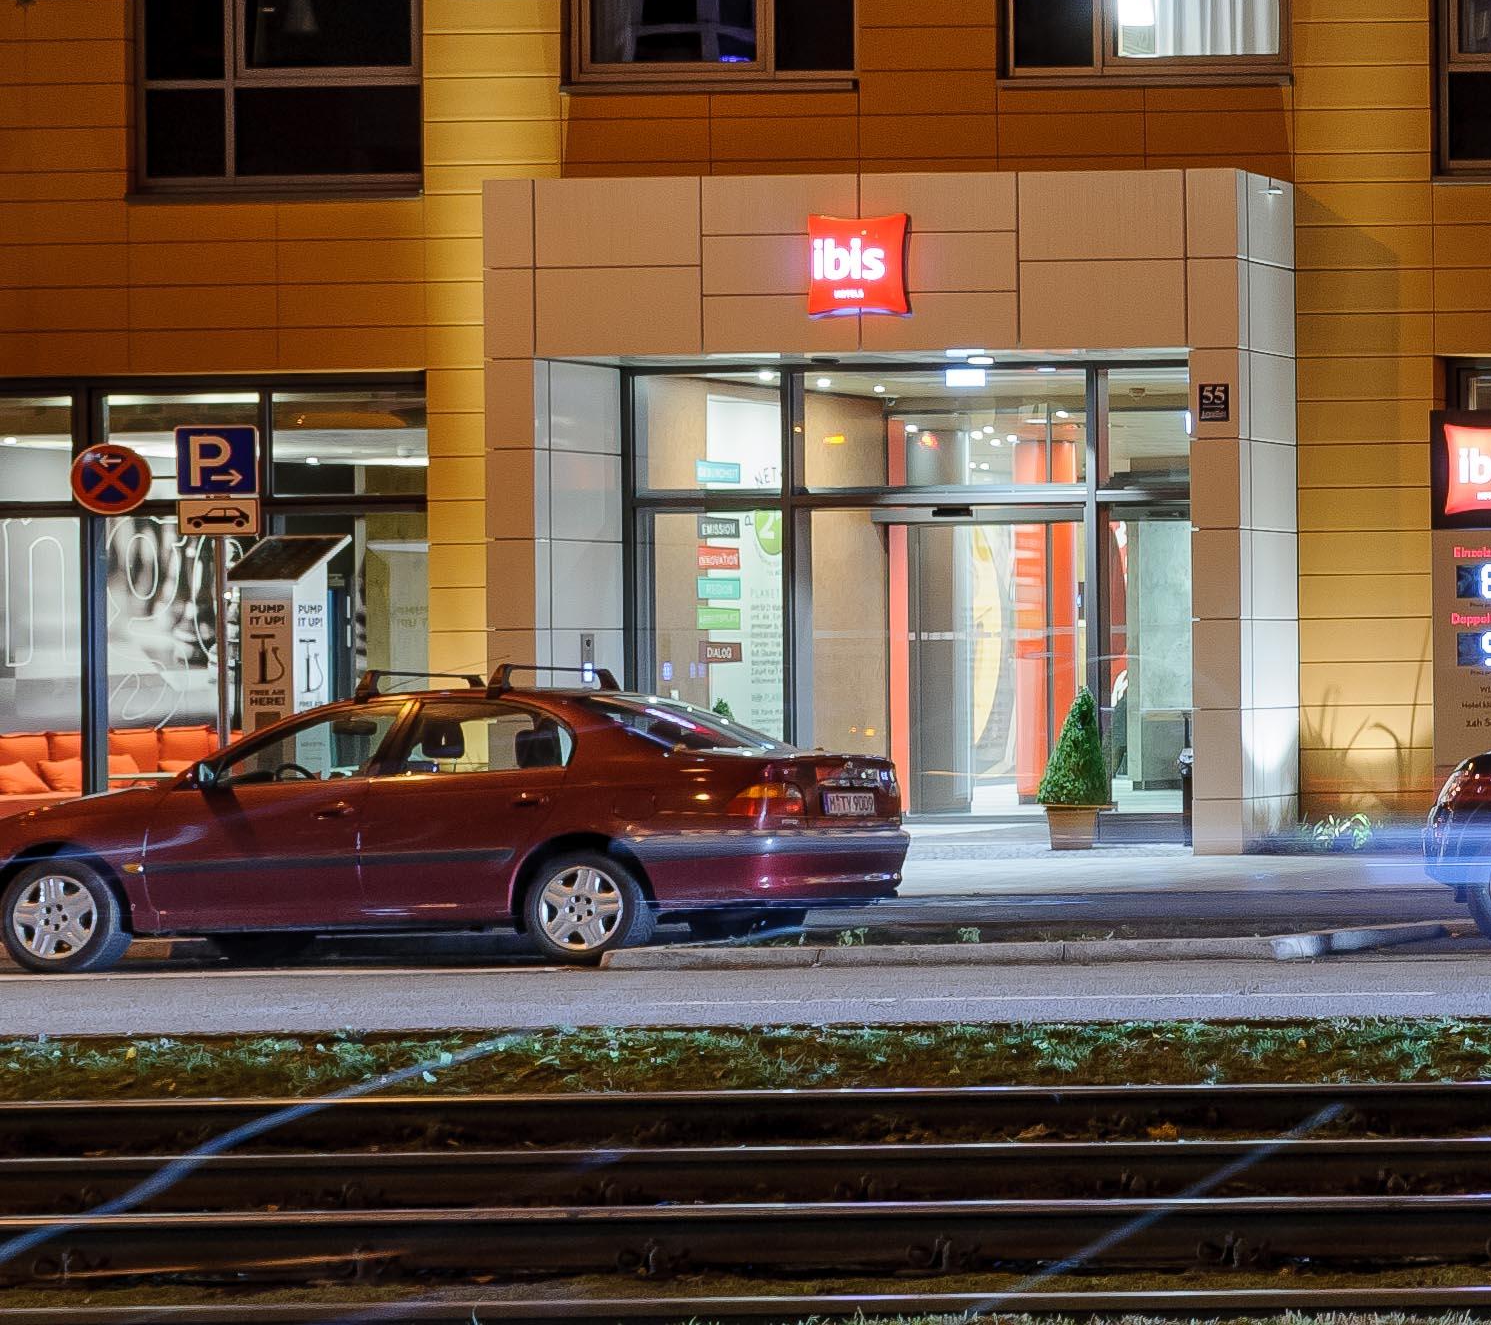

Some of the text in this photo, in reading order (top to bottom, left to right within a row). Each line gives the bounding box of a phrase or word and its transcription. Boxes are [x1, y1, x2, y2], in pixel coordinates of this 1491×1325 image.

[812, 236, 886, 281] ibis
[1202, 386, 1225, 404] 55
[189, 435, 231, 487] P
[701, 522, 736, 536] EMISSION
[250, 604, 285, 614] PUMP
[297, 604, 323, 615] PUMP
[250, 616, 285, 626] IT UP!
[298, 617, 323, 627] IT UP!
[706, 647, 732, 659] DIALOG
[250, 697, 285, 707] HERE!
[1461, 700, 1481, 709] Hotel
[1466, 719, 1483, 728] 24h
